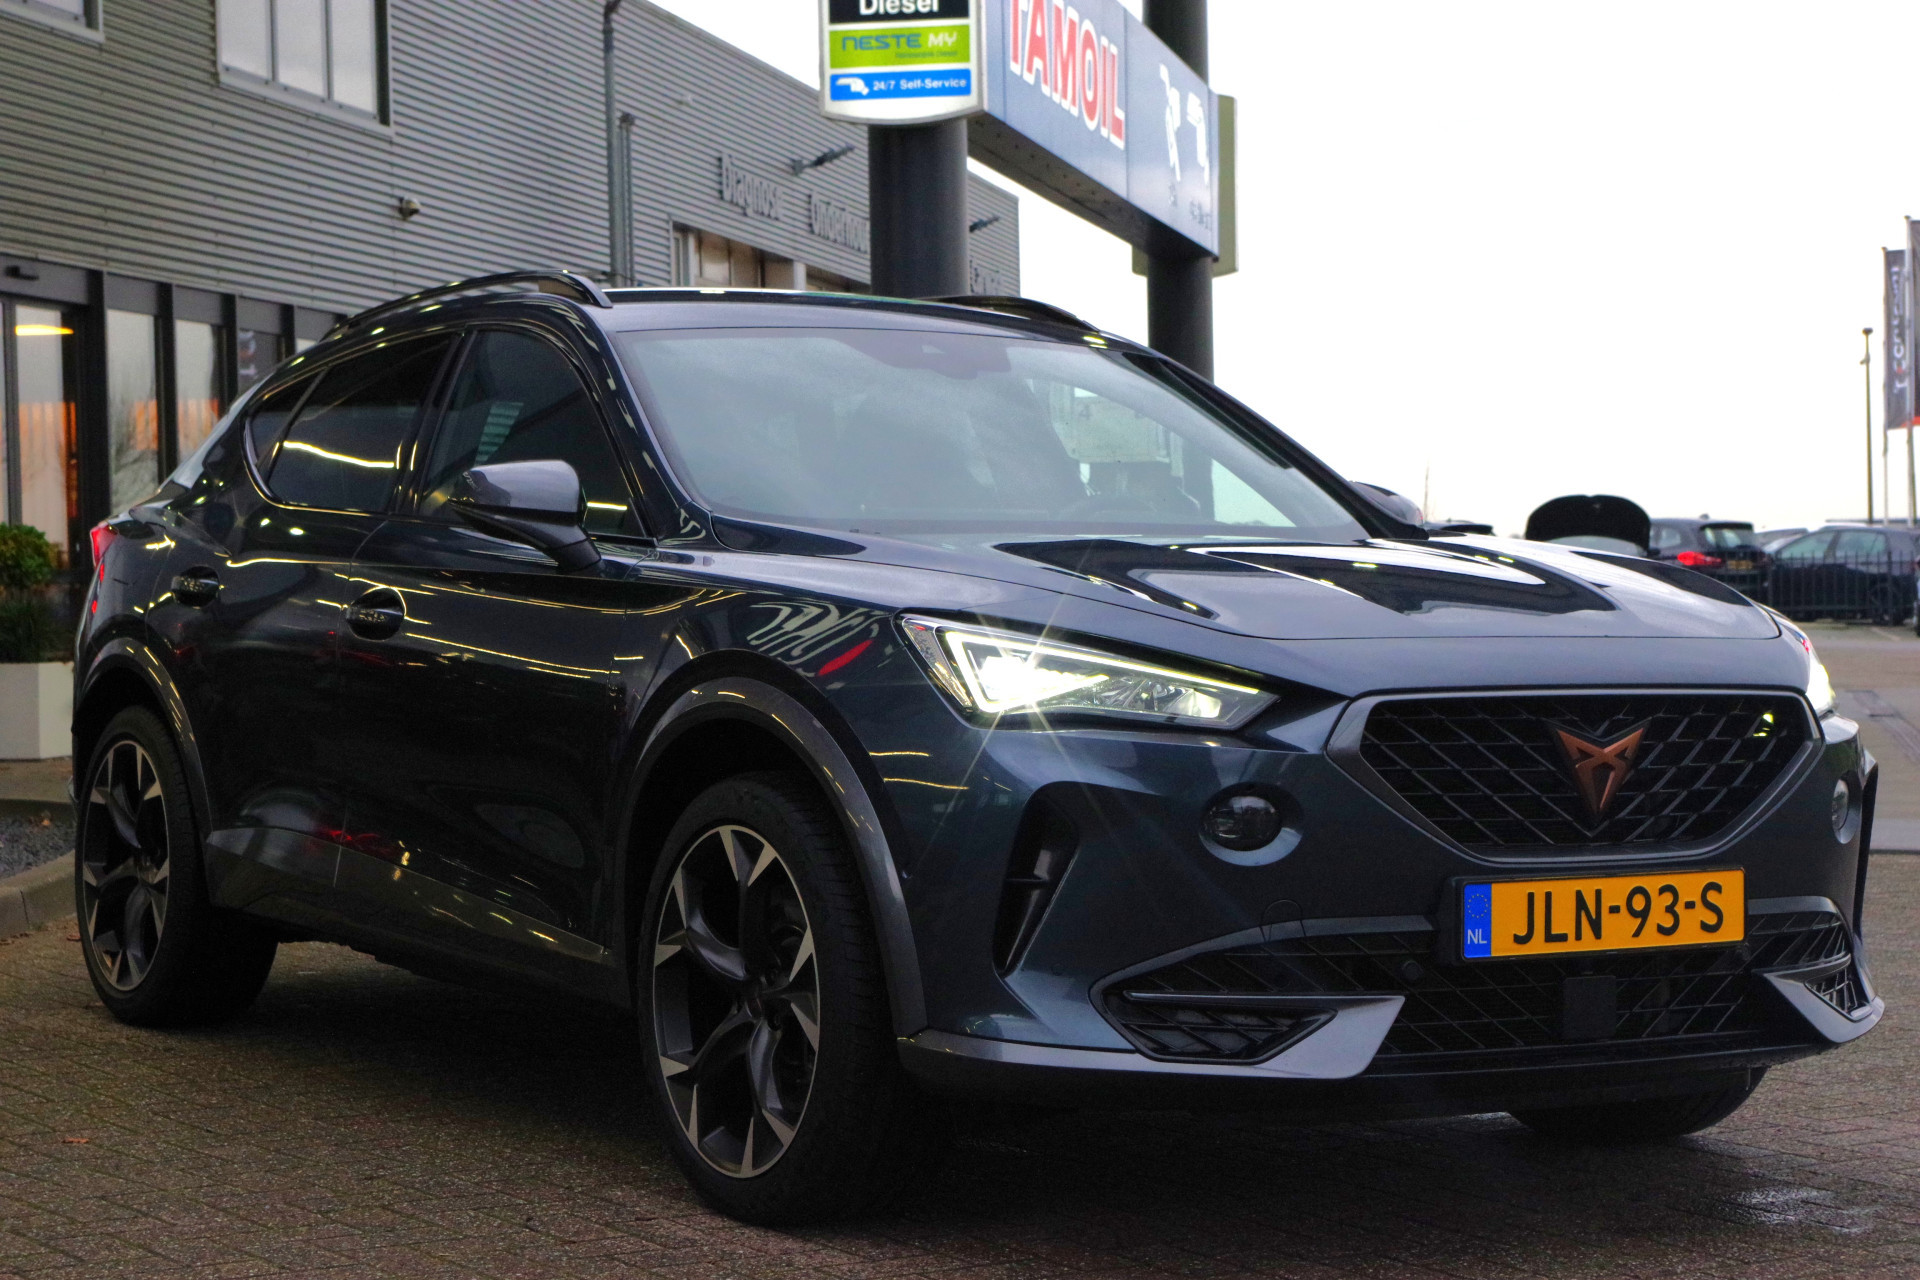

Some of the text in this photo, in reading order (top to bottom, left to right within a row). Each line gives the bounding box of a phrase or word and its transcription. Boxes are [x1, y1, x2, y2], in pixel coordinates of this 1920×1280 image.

[859, 0, 939, 15] Diesel
[927, 32, 958, 49] MY
[872, 78, 967, 91] 24/7 Self-Service
[1010, 0, 1126, 151] TAMOIL
[811, 190, 870, 255] Onderhou
[1467, 881, 1725, 946] NL JLN-93-S
